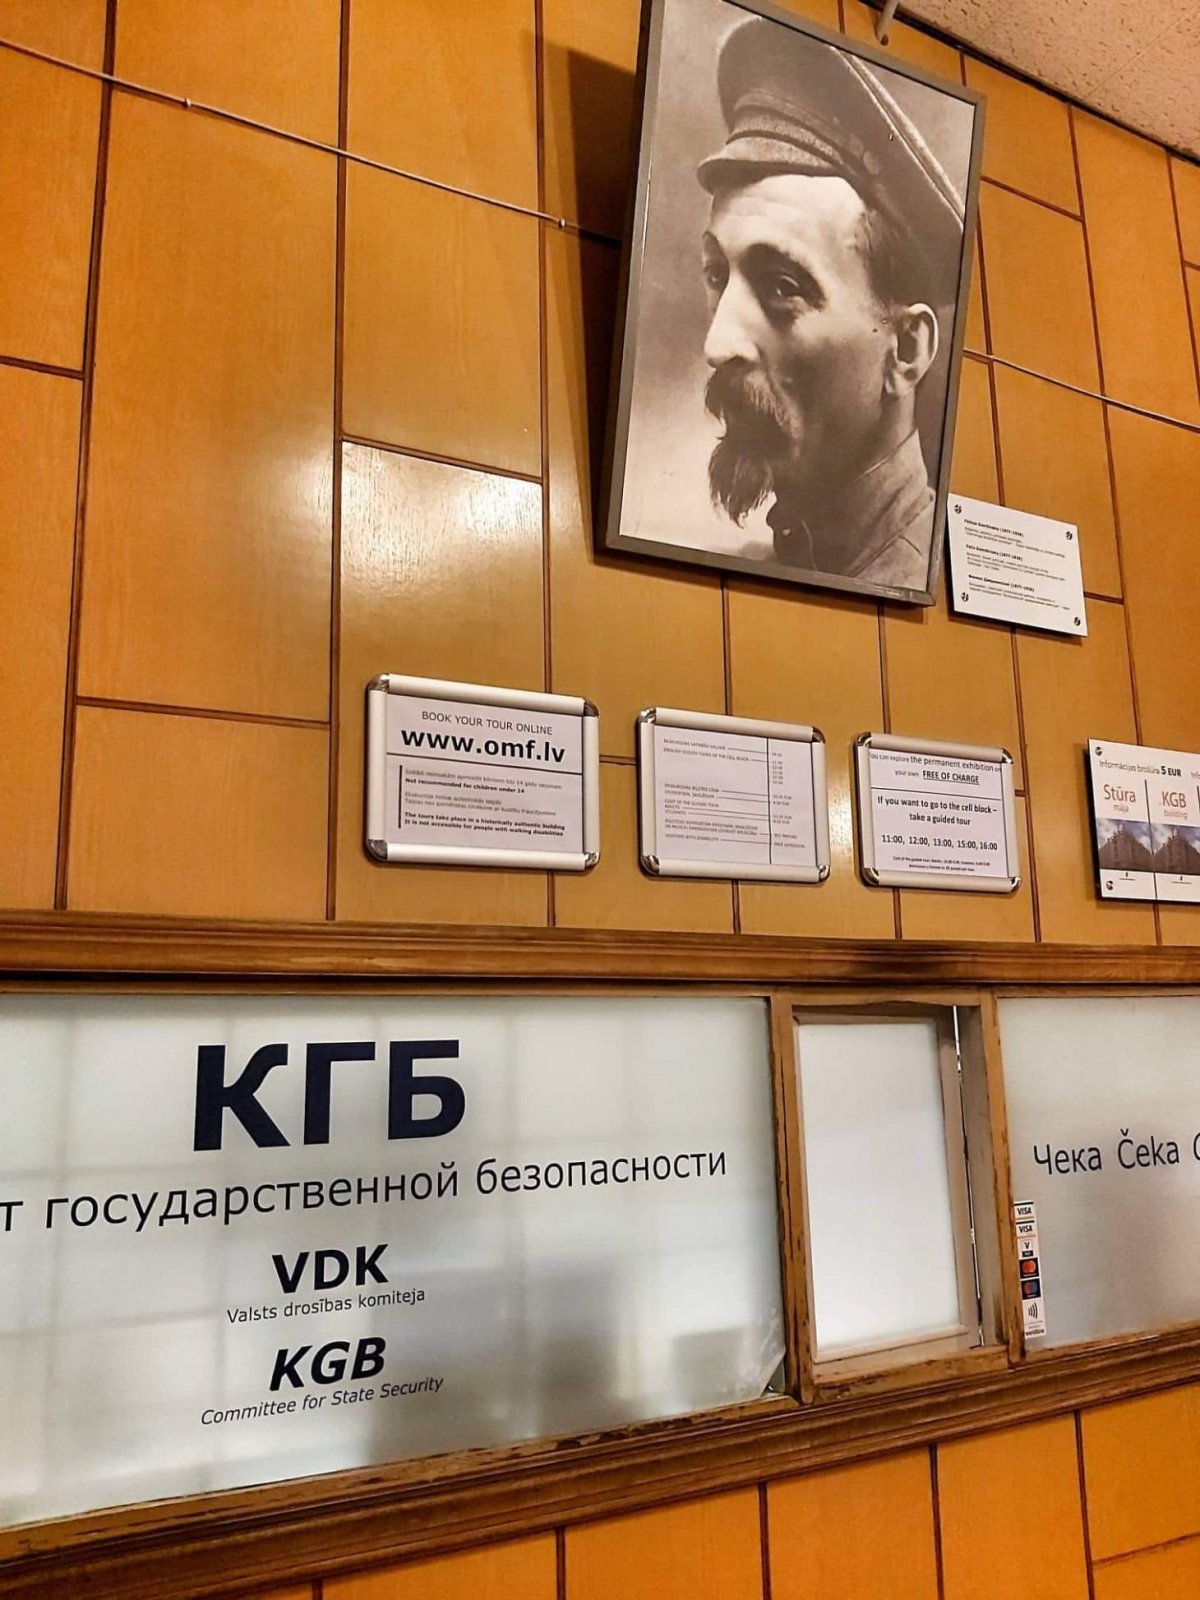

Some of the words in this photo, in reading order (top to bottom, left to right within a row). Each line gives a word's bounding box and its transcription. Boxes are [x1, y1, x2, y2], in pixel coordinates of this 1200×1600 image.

[422, 710, 451, 723] BOOK
[455, 715, 483, 727] YOUR
[486, 719, 513, 731] TOUR
[516, 723, 553, 735] ONLINE
[401, 730, 566, 763] www.omf.lv
[910, 755, 923, 764] the
[923, 758, 961, 769] permanent
[962, 761, 994, 772] exhibition
[1160, 765, 1166, 775] 5
[1167, 767, 1182, 778] EUR
[922, 770, 939, 779] FREE
[941, 771, 951, 780] OF
[952, 773, 980, 783] CHARGE
[1103, 784, 1136, 803] Stūra
[1161, 790, 1187, 808] KGB
[877, 796, 883, 804] If
[885, 797, 900, 806] you
[901, 798, 919, 807] want
[921, 800, 929, 808] to
[930, 802, 939, 810] go
[940, 801, 948, 809] to
[949, 801, 960, 810] the
[961, 803, 973, 812] cell
[974, 804, 991, 814] block
[481, 818, 512, 826] historically
[909, 813, 926, 822] take
[932, 814, 955, 824] guided
[956, 817, 971, 826] tour
[881, 834, 905, 845] 11:00,
[908, 836, 930, 847] 12:00,
[933, 838, 954, 848] 13:00,
[957, 840, 978, 850] 15:00,
[979, 841, 998, 851] 16:00
[194, 1040, 466, 1152] КГБ
[1118, 1128, 1180, 1170] Čeka
[1034, 1144, 1103, 1176] Чека
[46, 1160, 458, 1233] государственной
[477, 1151, 726, 1195] безопасности
[1017, 1206, 1032, 1216] VISA
[1018, 1224, 1033, 1233] VISA
[272, 1244, 389, 1294] VDK
[227, 1306, 278, 1324] Valsts
[283, 1297, 352, 1318] drosības
[358, 1290, 425, 1308] komiteja
[269, 1337, 387, 1391] KGB
[201, 1400, 297, 1425] Committee
[302, 1393, 327, 1411] for
[331, 1388, 375, 1406] State
[380, 1377, 444, 1399] Security
